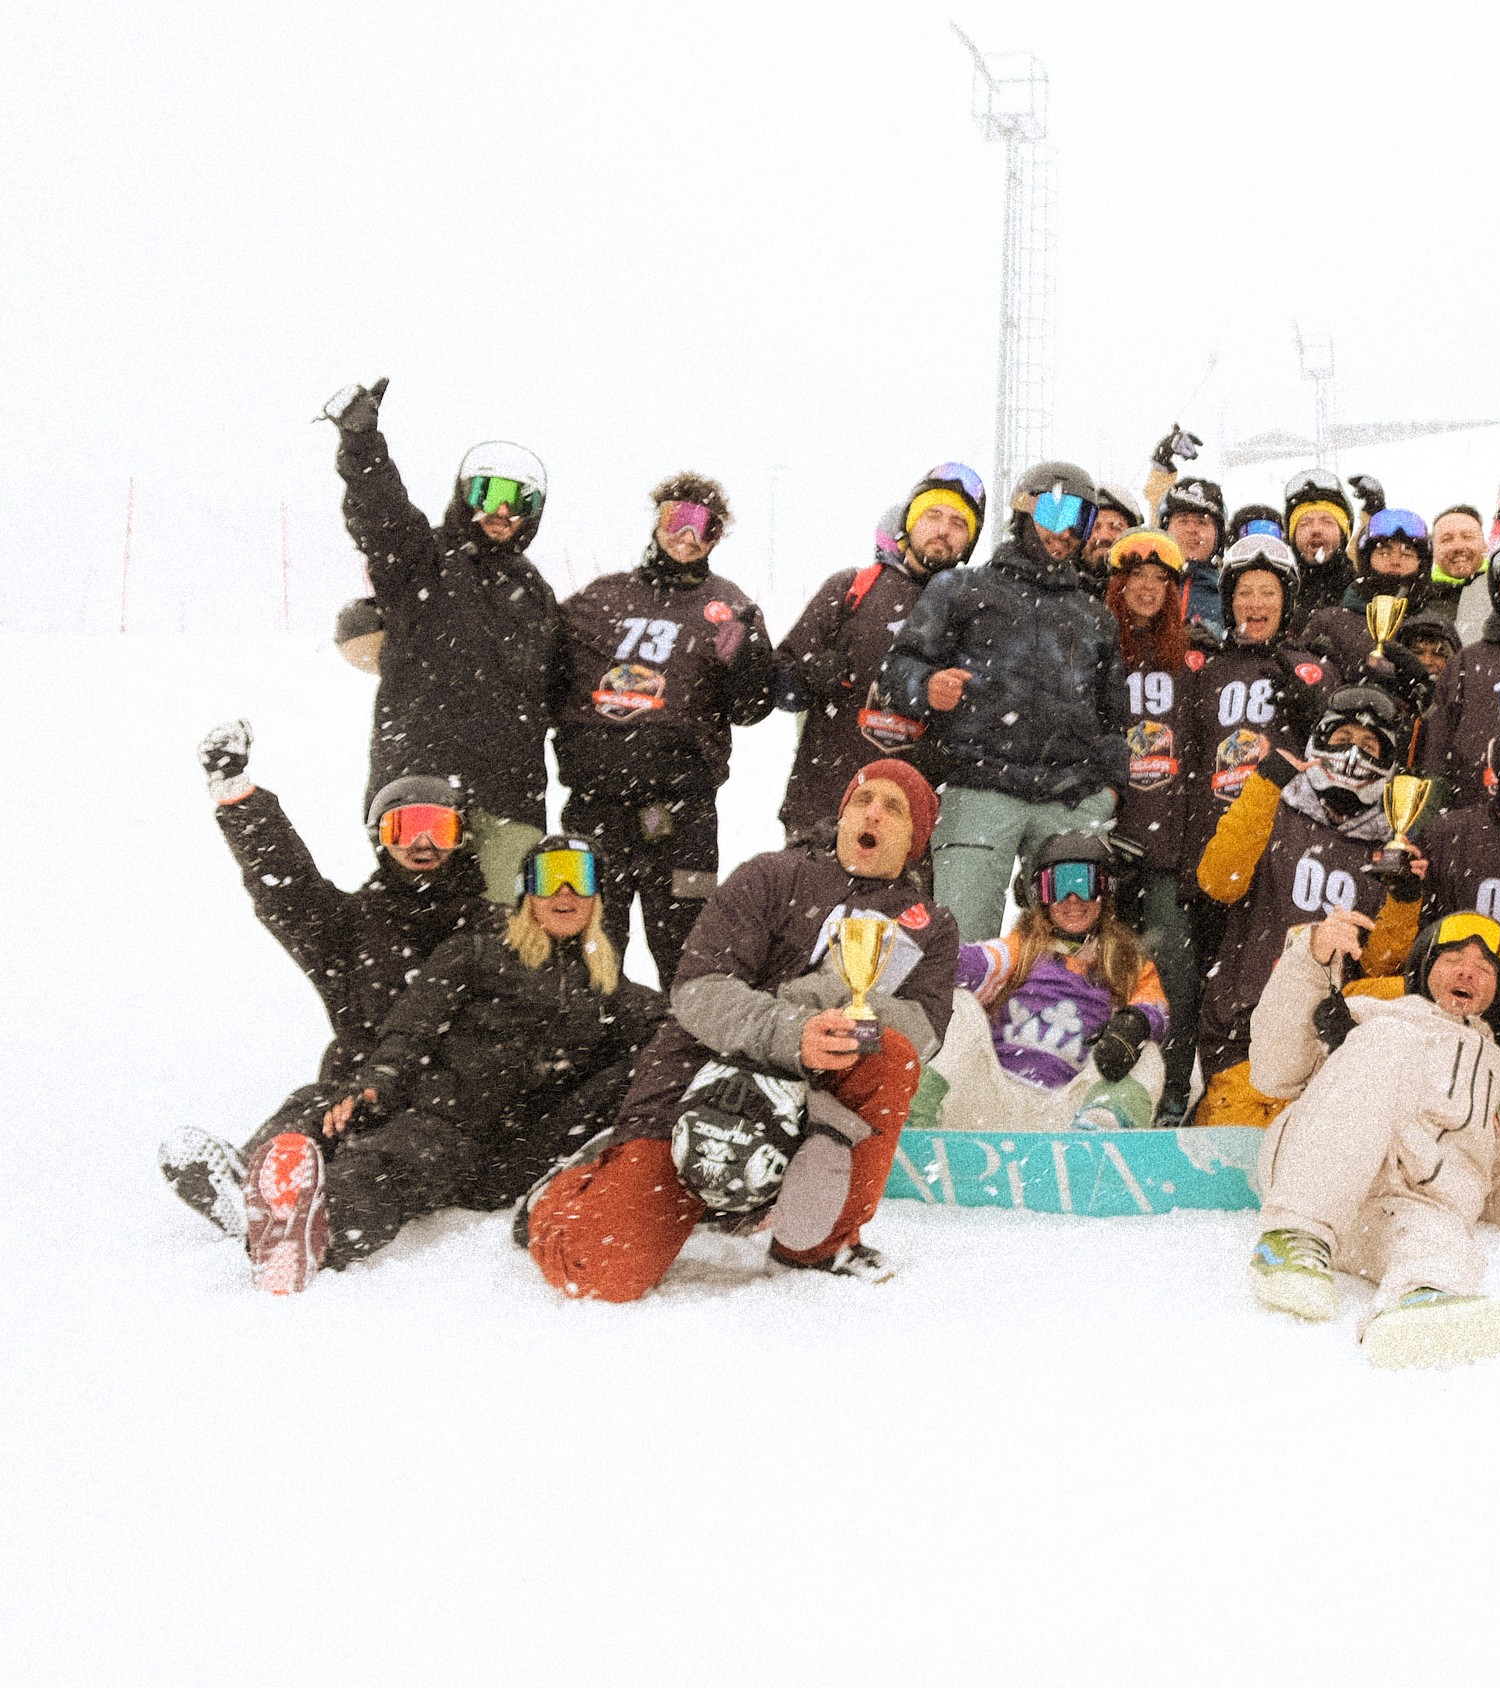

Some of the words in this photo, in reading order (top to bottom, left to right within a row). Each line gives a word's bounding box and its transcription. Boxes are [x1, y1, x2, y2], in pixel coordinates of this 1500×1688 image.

[614, 617, 680, 664] 73
[1127, 671, 1174, 715] 19
[1218, 679, 1276, 726] 08
[1292, 857, 1356, 916] 09
